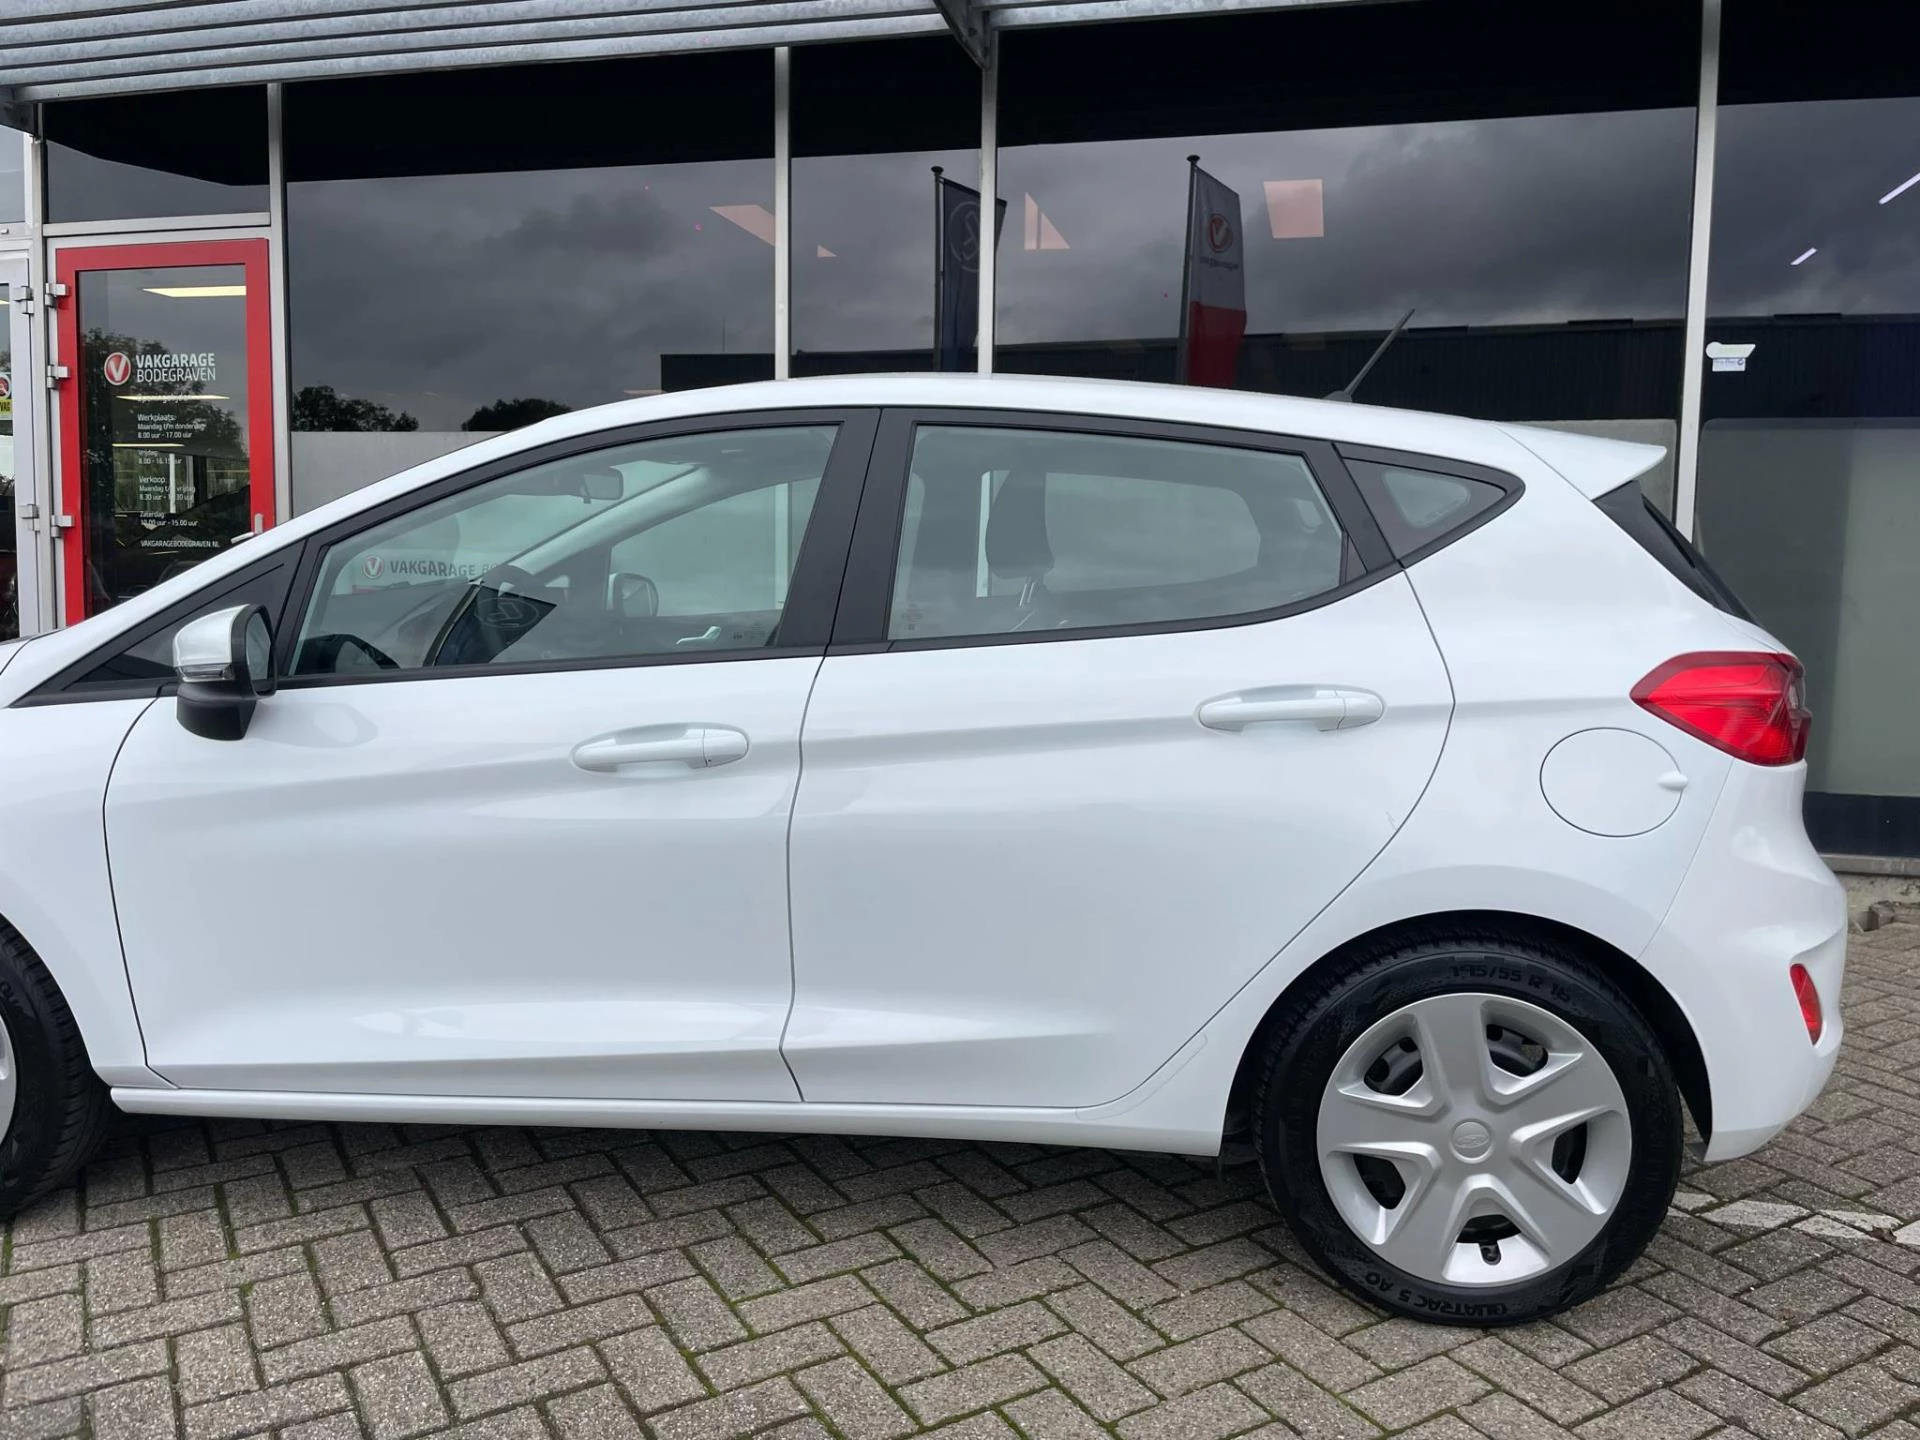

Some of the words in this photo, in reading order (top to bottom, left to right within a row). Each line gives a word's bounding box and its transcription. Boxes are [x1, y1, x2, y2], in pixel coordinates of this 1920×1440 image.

[136, 353, 215, 368] VAKGARAGE
[137, 368, 216, 383] BODEGRAVEN
[137, 414, 177, 423] Werkplaats:
[137, 423, 162, 431] Maandag
[166, 431, 182, 439] 17.00
[172, 519, 188, 527] 15.00
[390, 560, 476, 576] VAKGARAGE
[1413, 1294, 1508, 1316] QUATRAC
